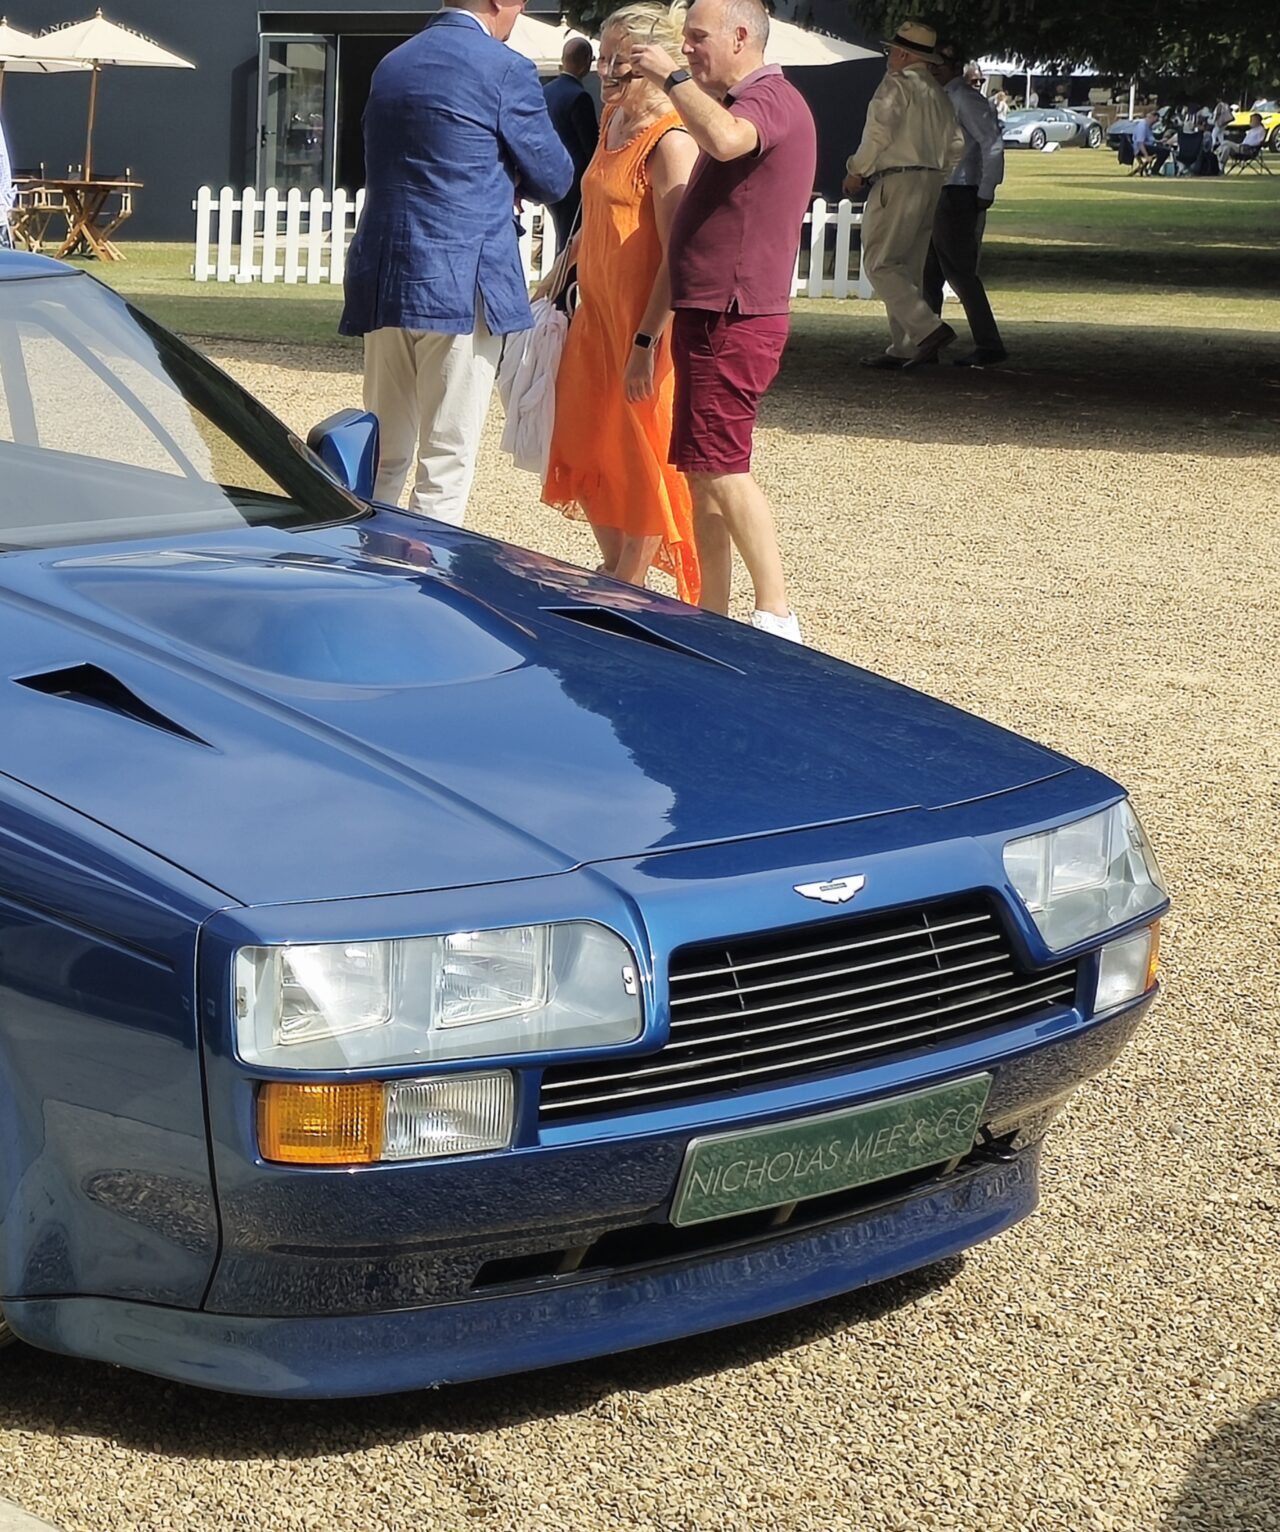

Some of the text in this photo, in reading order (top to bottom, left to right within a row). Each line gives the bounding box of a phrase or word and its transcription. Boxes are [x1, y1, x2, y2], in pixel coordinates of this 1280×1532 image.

[687, 1103, 979, 1199] NICHOLAS MEE & CO
